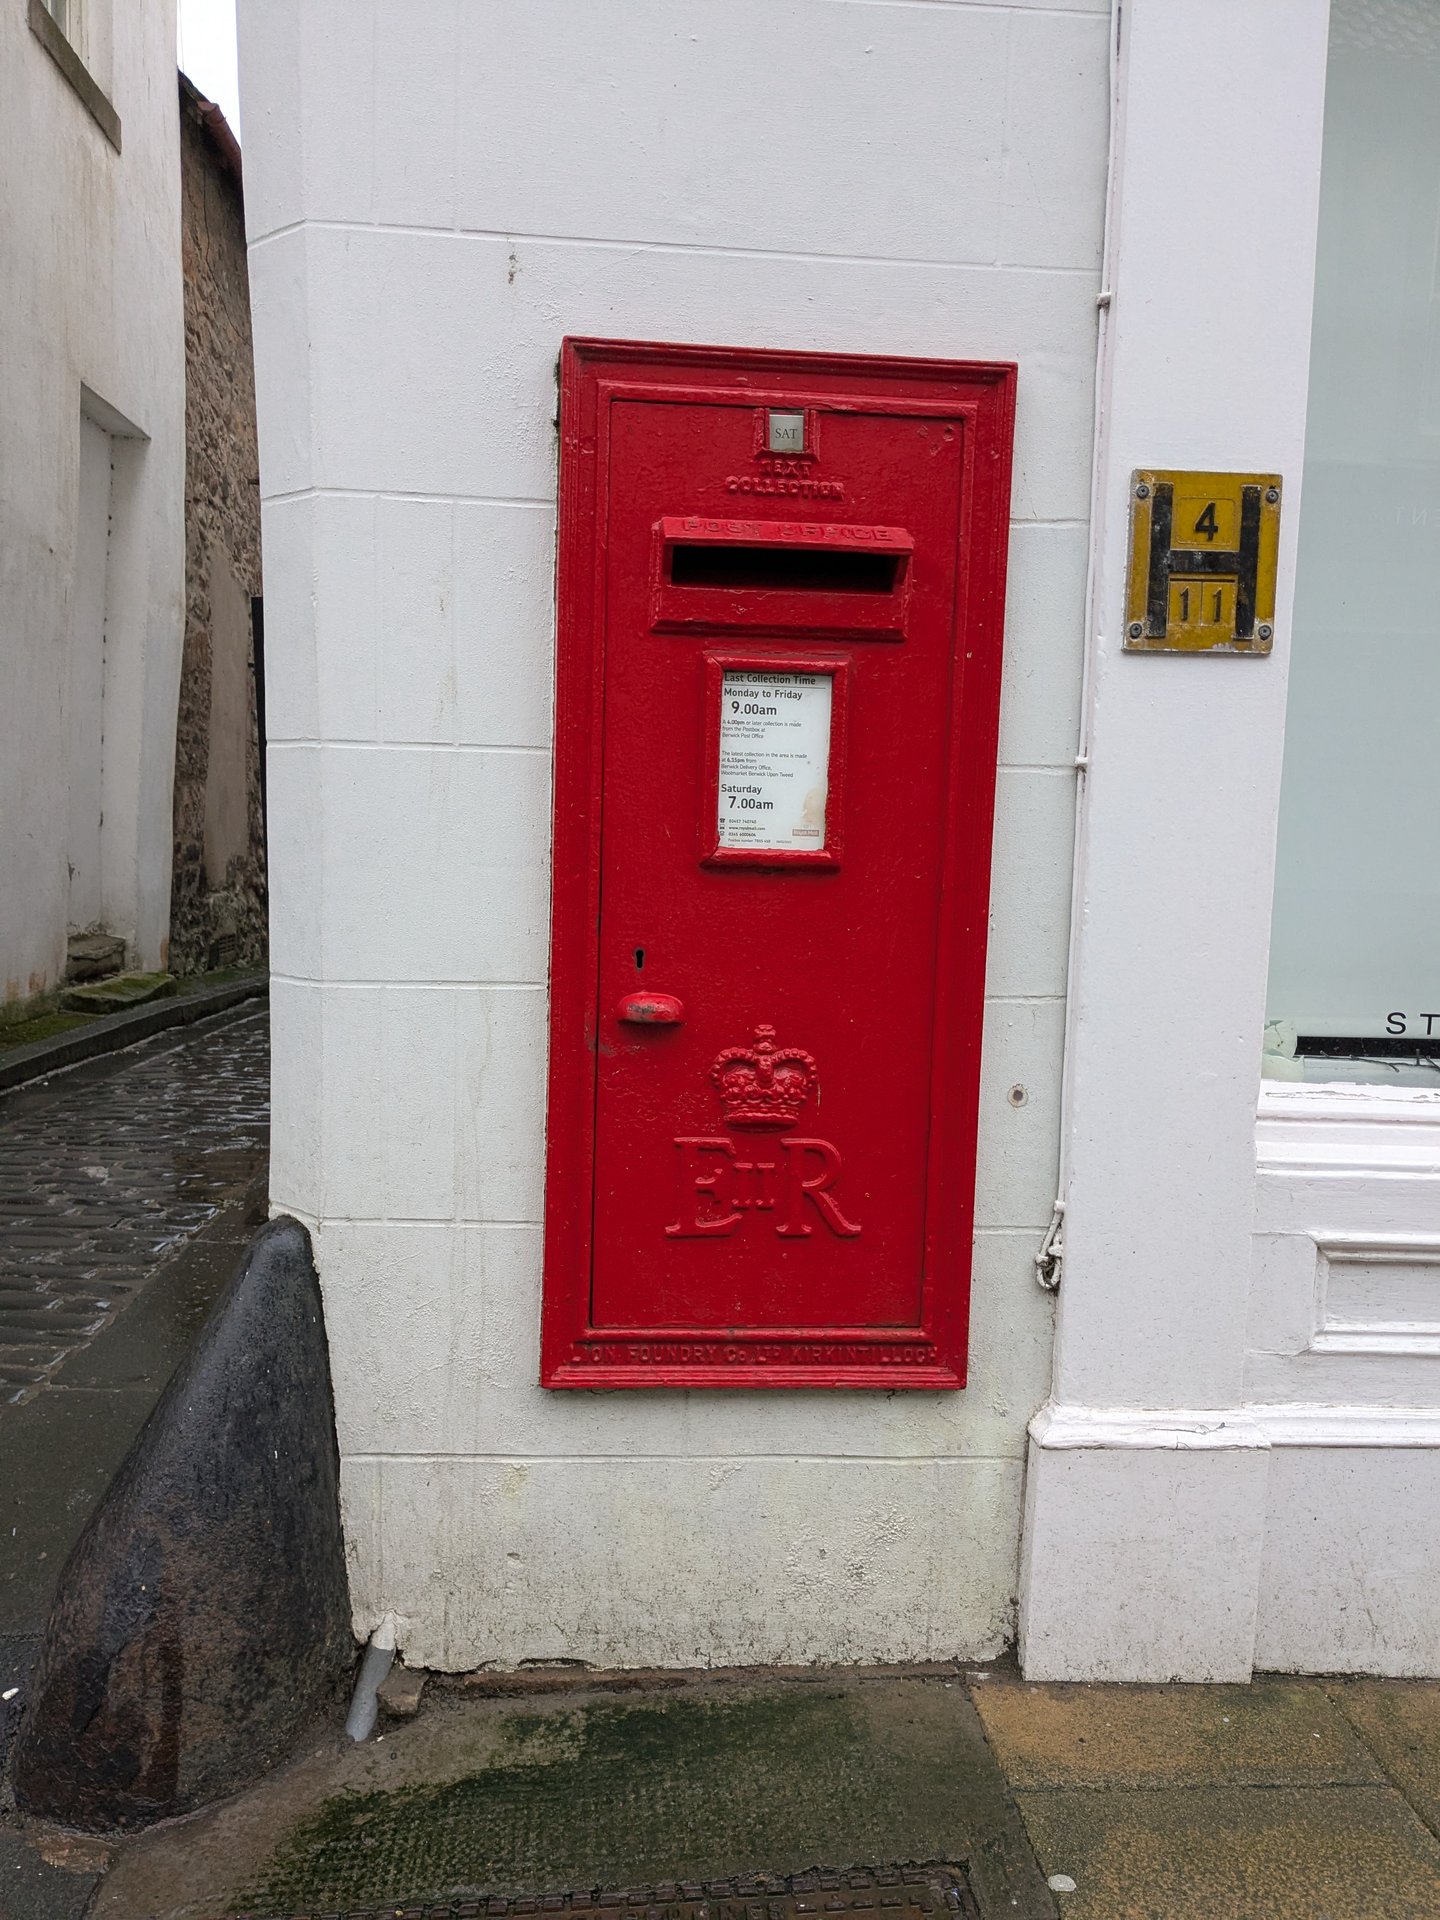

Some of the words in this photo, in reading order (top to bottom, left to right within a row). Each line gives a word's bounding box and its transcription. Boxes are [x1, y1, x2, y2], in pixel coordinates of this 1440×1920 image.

[775, 428, 797, 439] SAT
[725, 476, 844, 500] COLLECTION
[1195, 501, 1219, 542] 4
[681, 518, 762, 538] POST
[777, 522, 893, 542] OFFICE
[724, 672, 744, 683] Last
[746, 673, 791, 685] Collection
[793, 675, 816, 685] Time
[724, 688, 759, 700] Monday
[762, 691, 772, 699] to
[774, 690, 802, 701] Friday
[731, 701, 777, 716] 9.00am
[721, 784, 762, 795] Saturday
[728, 796, 774, 810] 7.00am
[627, 1345, 716, 1363] FOUNDRY
